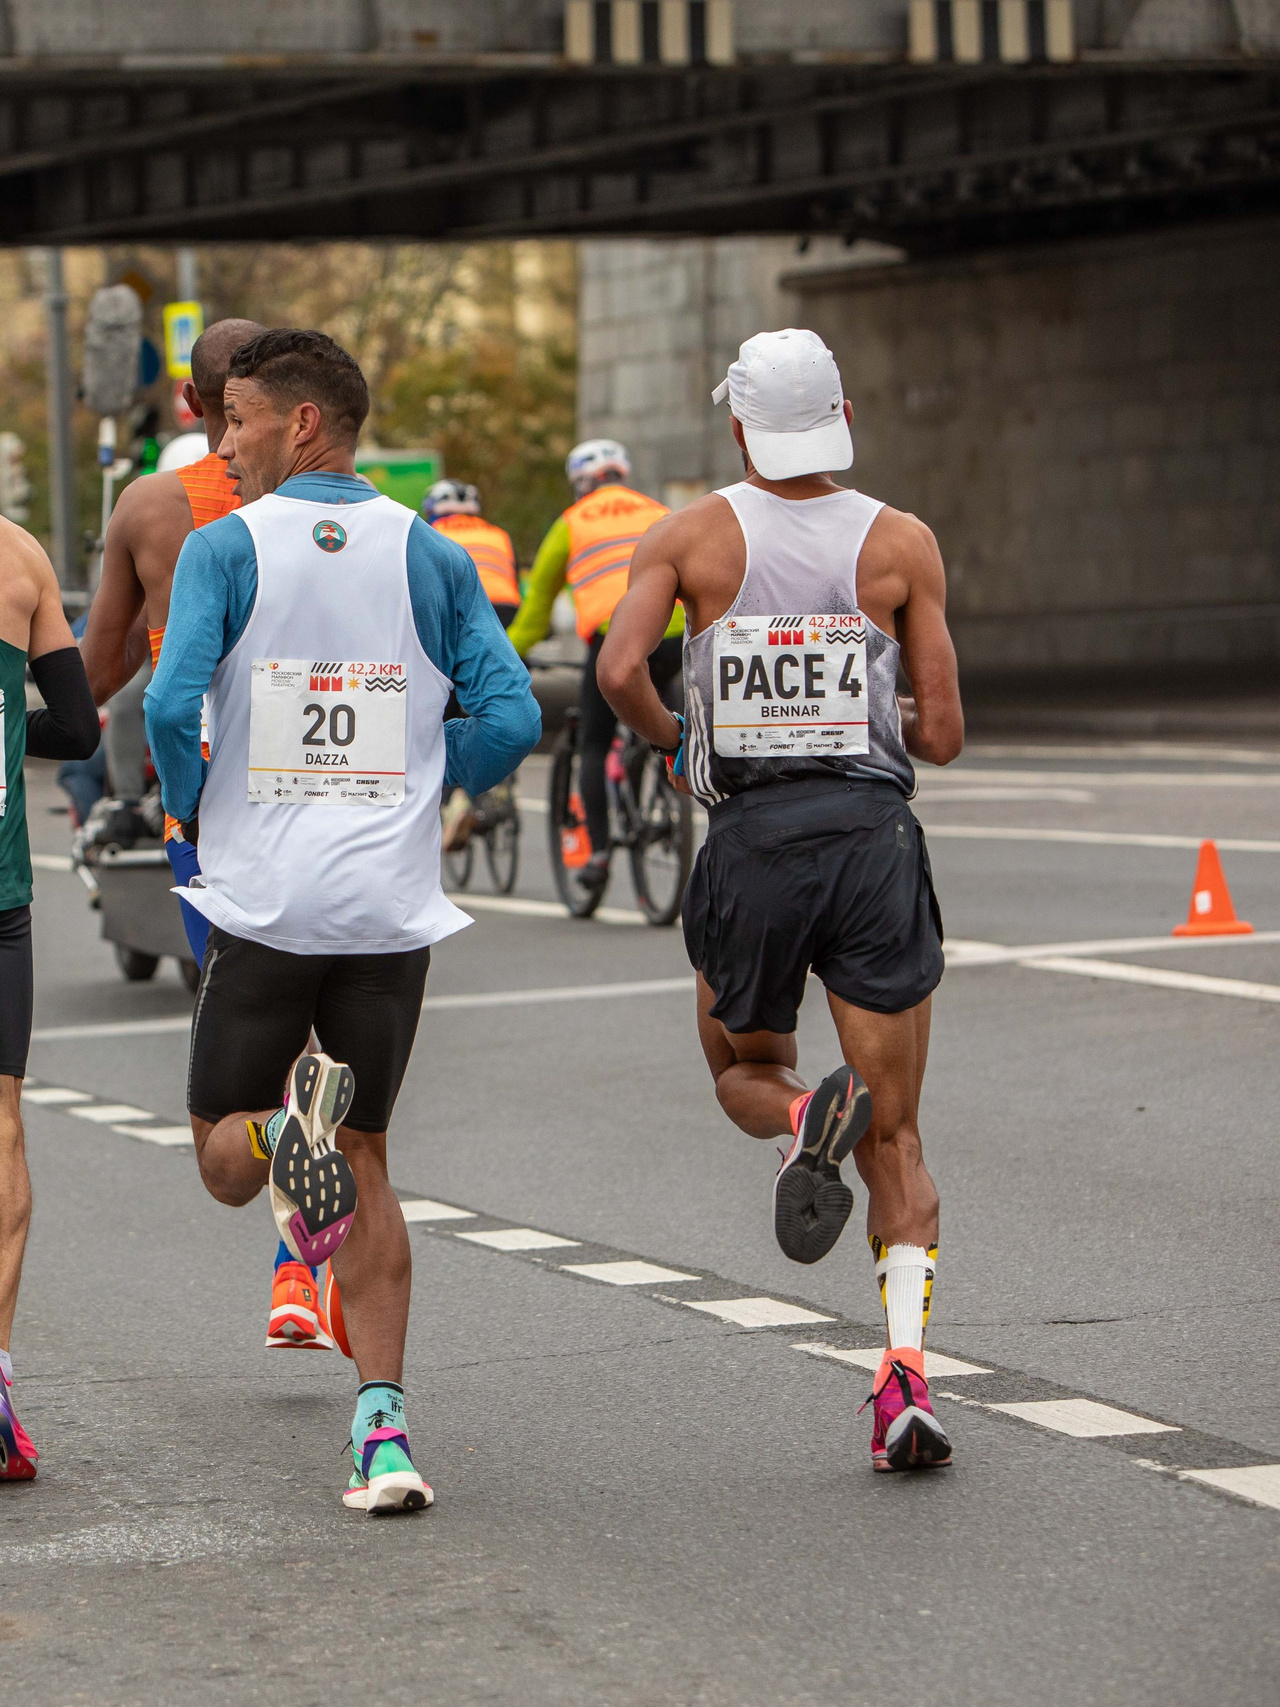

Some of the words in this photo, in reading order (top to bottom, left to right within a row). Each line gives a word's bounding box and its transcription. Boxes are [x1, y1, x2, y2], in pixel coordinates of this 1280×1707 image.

[808, 616, 837, 629] 42,2
[347, 663, 377, 676] 42,2
[720, 653, 826, 701] PACE
[838, 653, 862, 698] 4
[761, 705, 820, 718] BENNAR
[302, 703, 356, 747] 20
[305, 753, 349, 766] DAZZA
